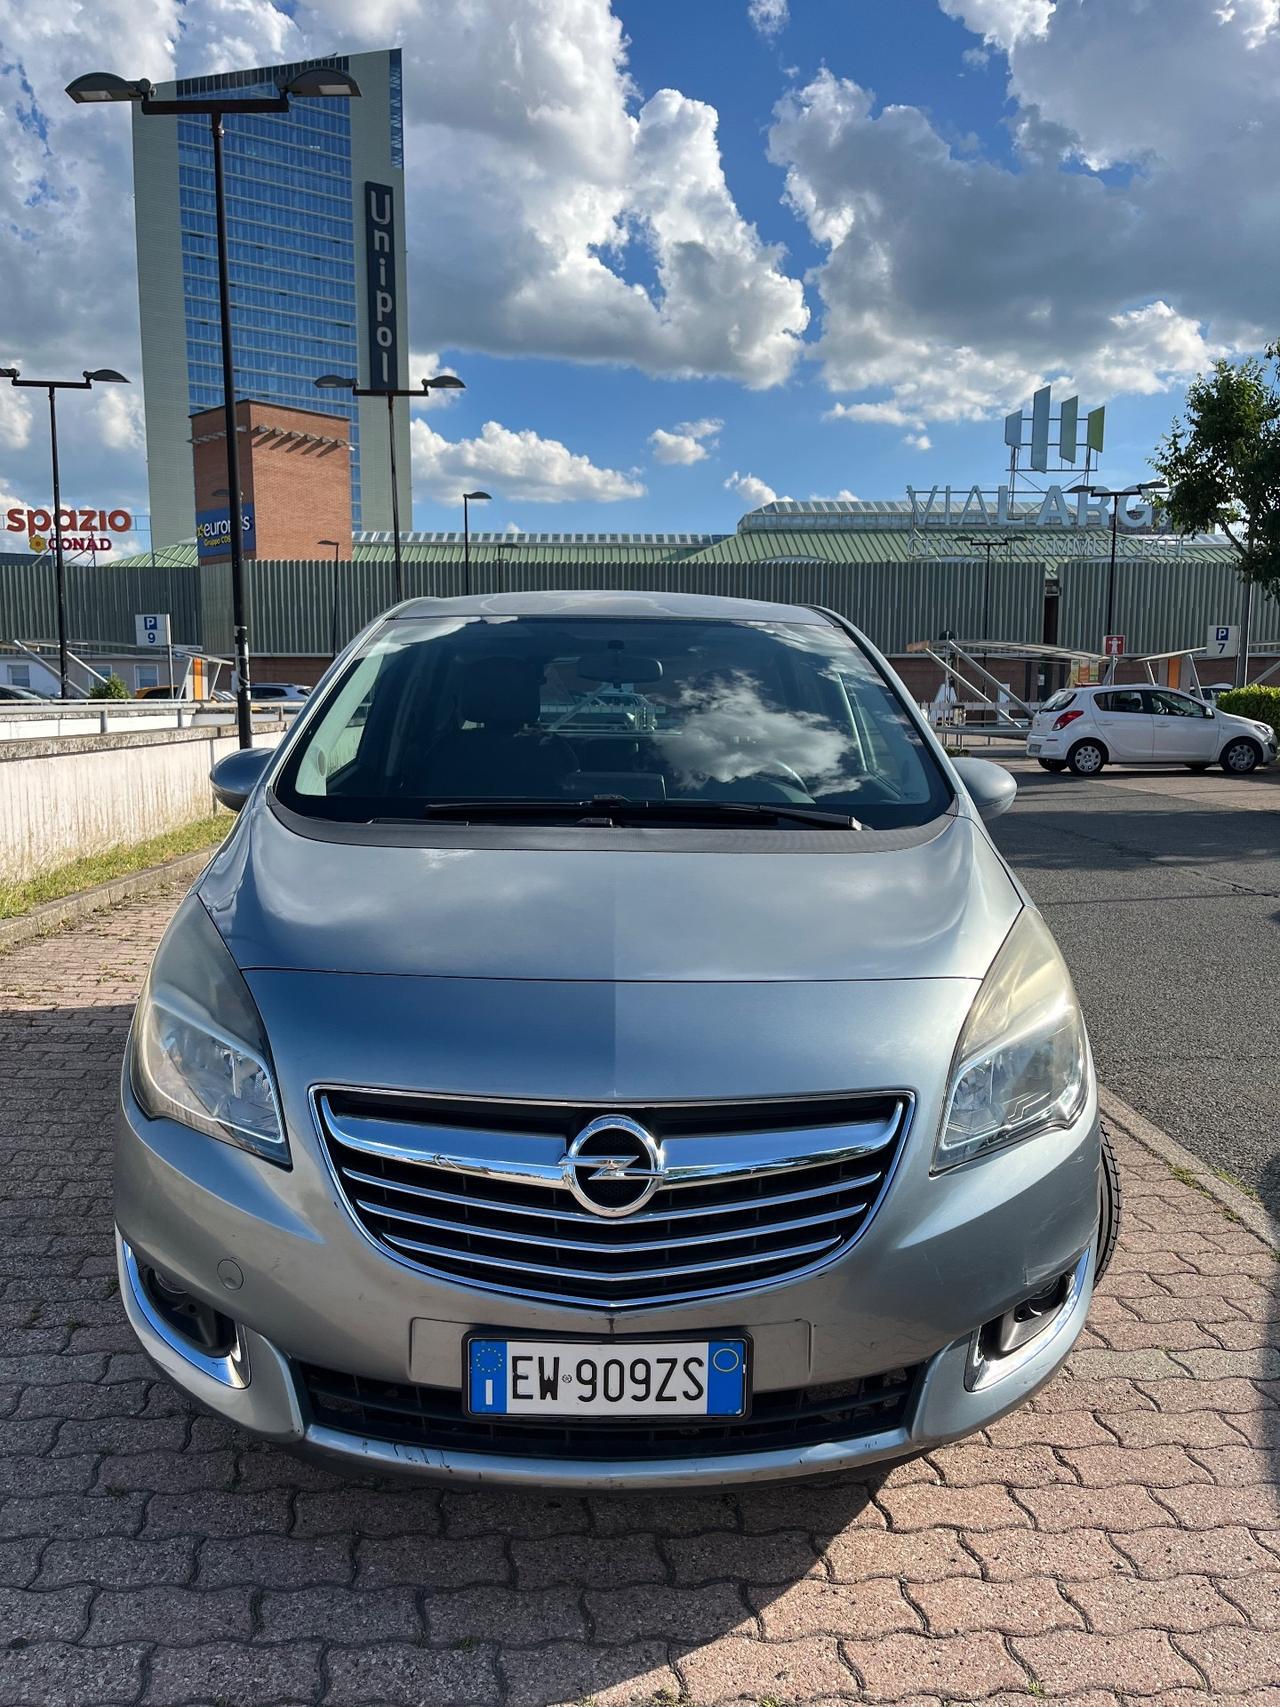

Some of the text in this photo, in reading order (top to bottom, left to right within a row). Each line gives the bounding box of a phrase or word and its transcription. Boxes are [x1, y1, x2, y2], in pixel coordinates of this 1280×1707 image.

[370, 190, 393, 383] Unipol
[7, 508, 132, 537] spazio
[203, 516, 250, 537] euros
[48, 538, 112, 551] CONAD
[146, 617, 155, 629] P
[147, 632, 156, 644] 9
[1218, 628, 1226, 640] P
[1217, 643, 1226, 654] 7
